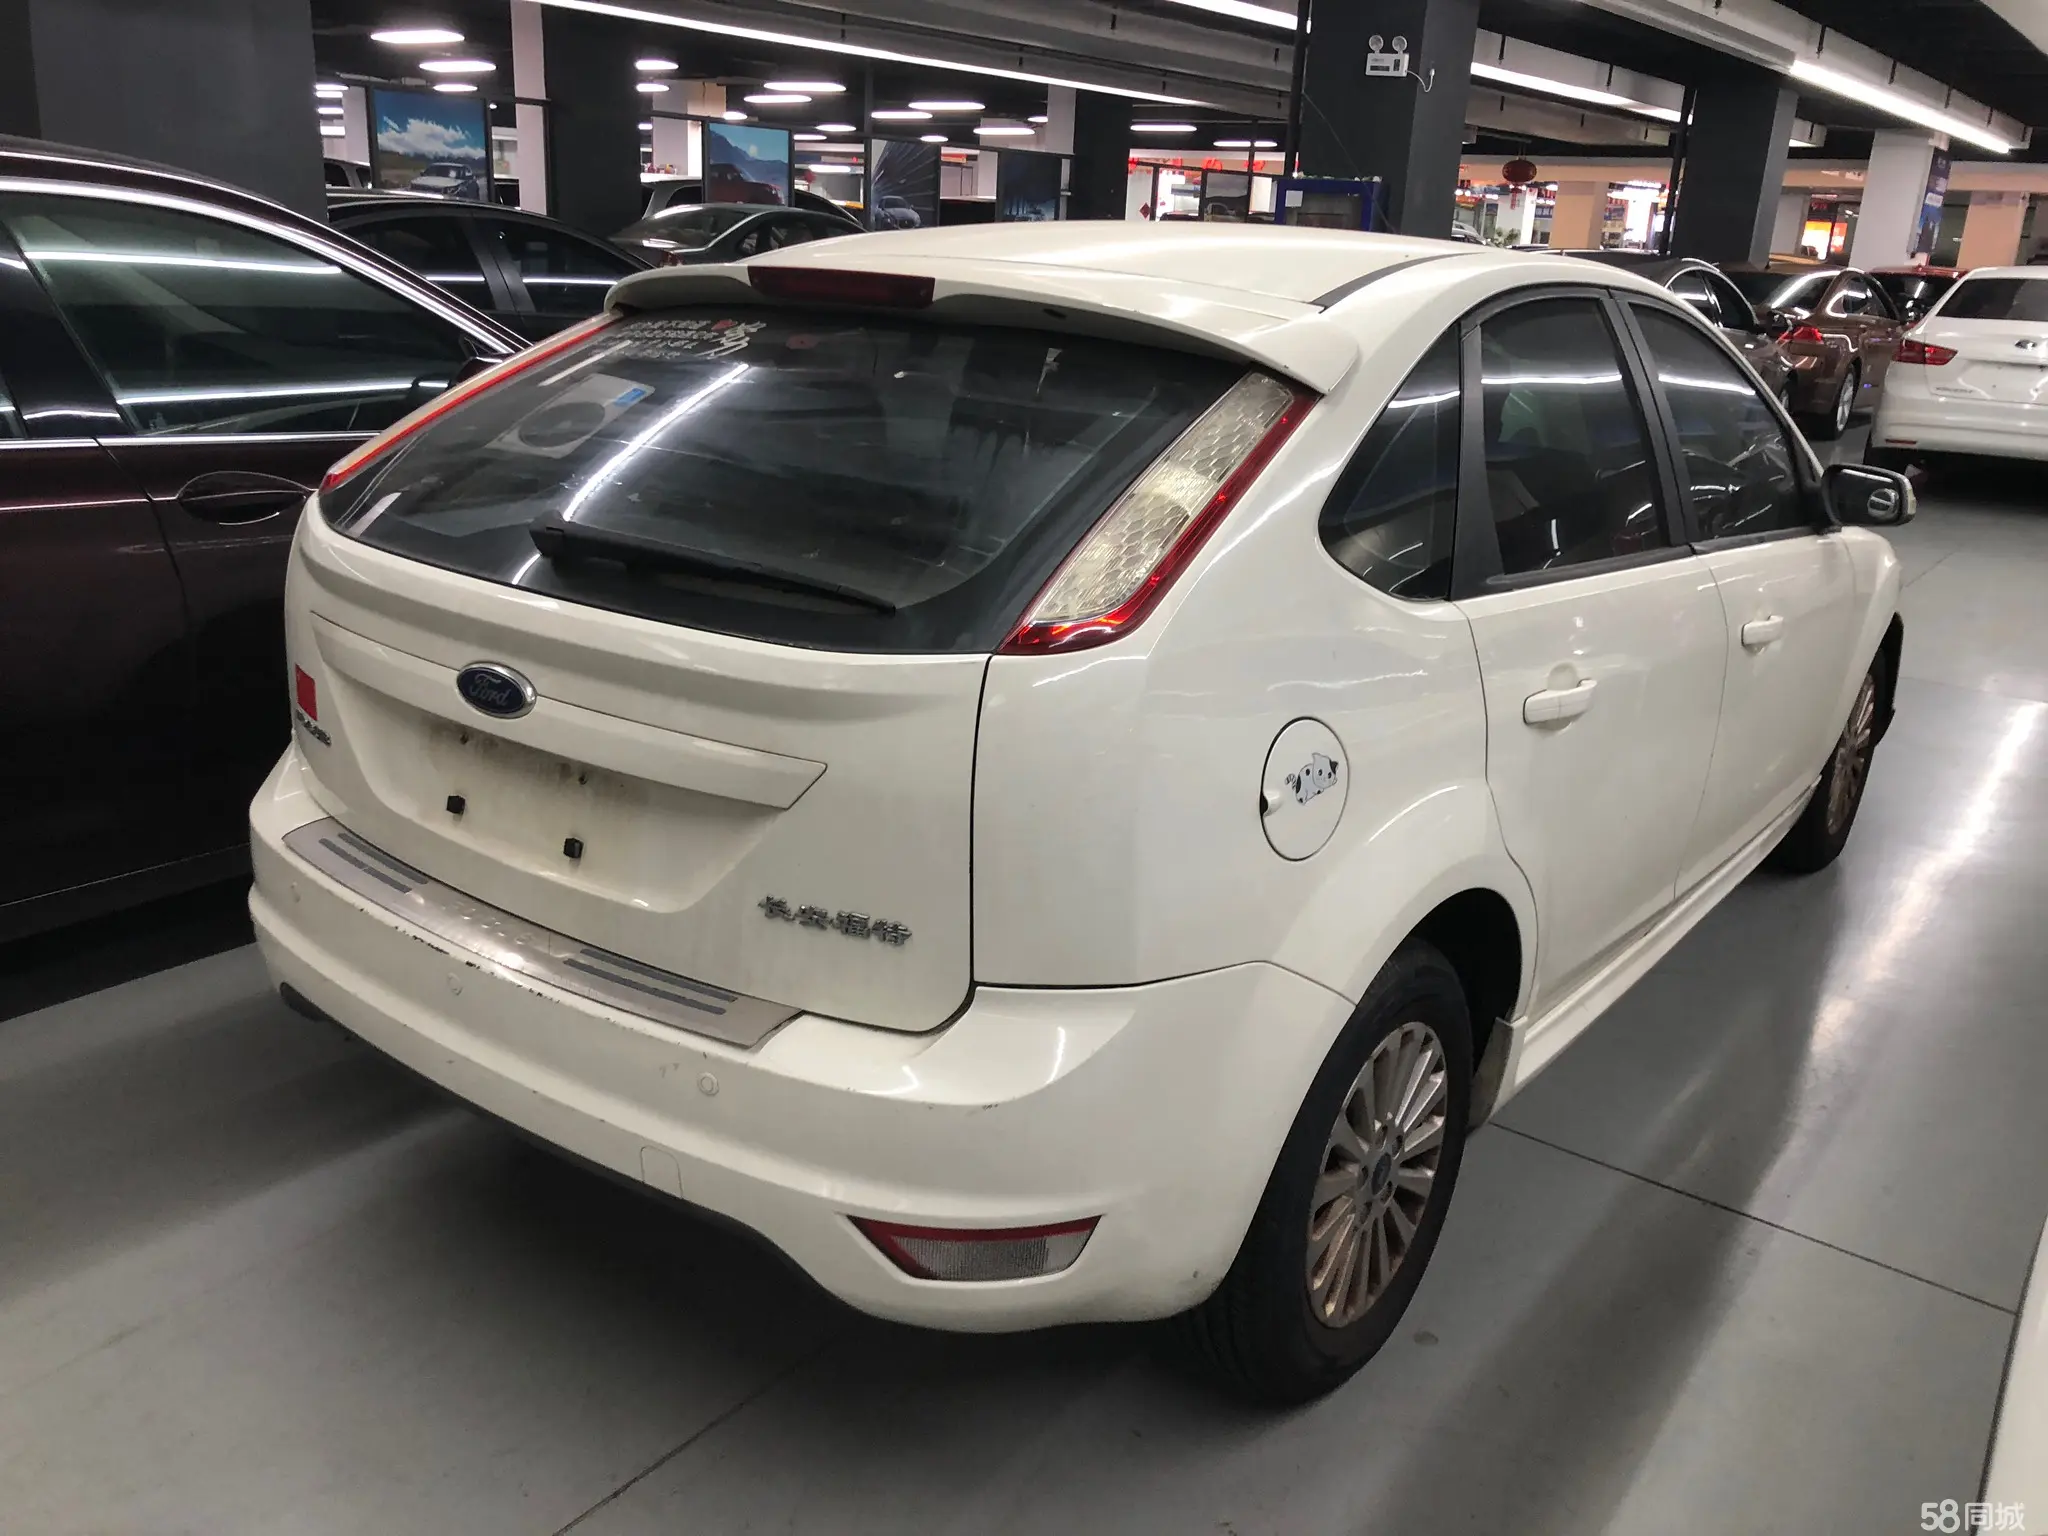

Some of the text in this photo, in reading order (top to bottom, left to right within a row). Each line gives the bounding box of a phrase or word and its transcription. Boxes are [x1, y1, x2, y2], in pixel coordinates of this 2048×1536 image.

[468, 672, 513, 707] Ford
[757, 894, 913, 946] 长安福特
